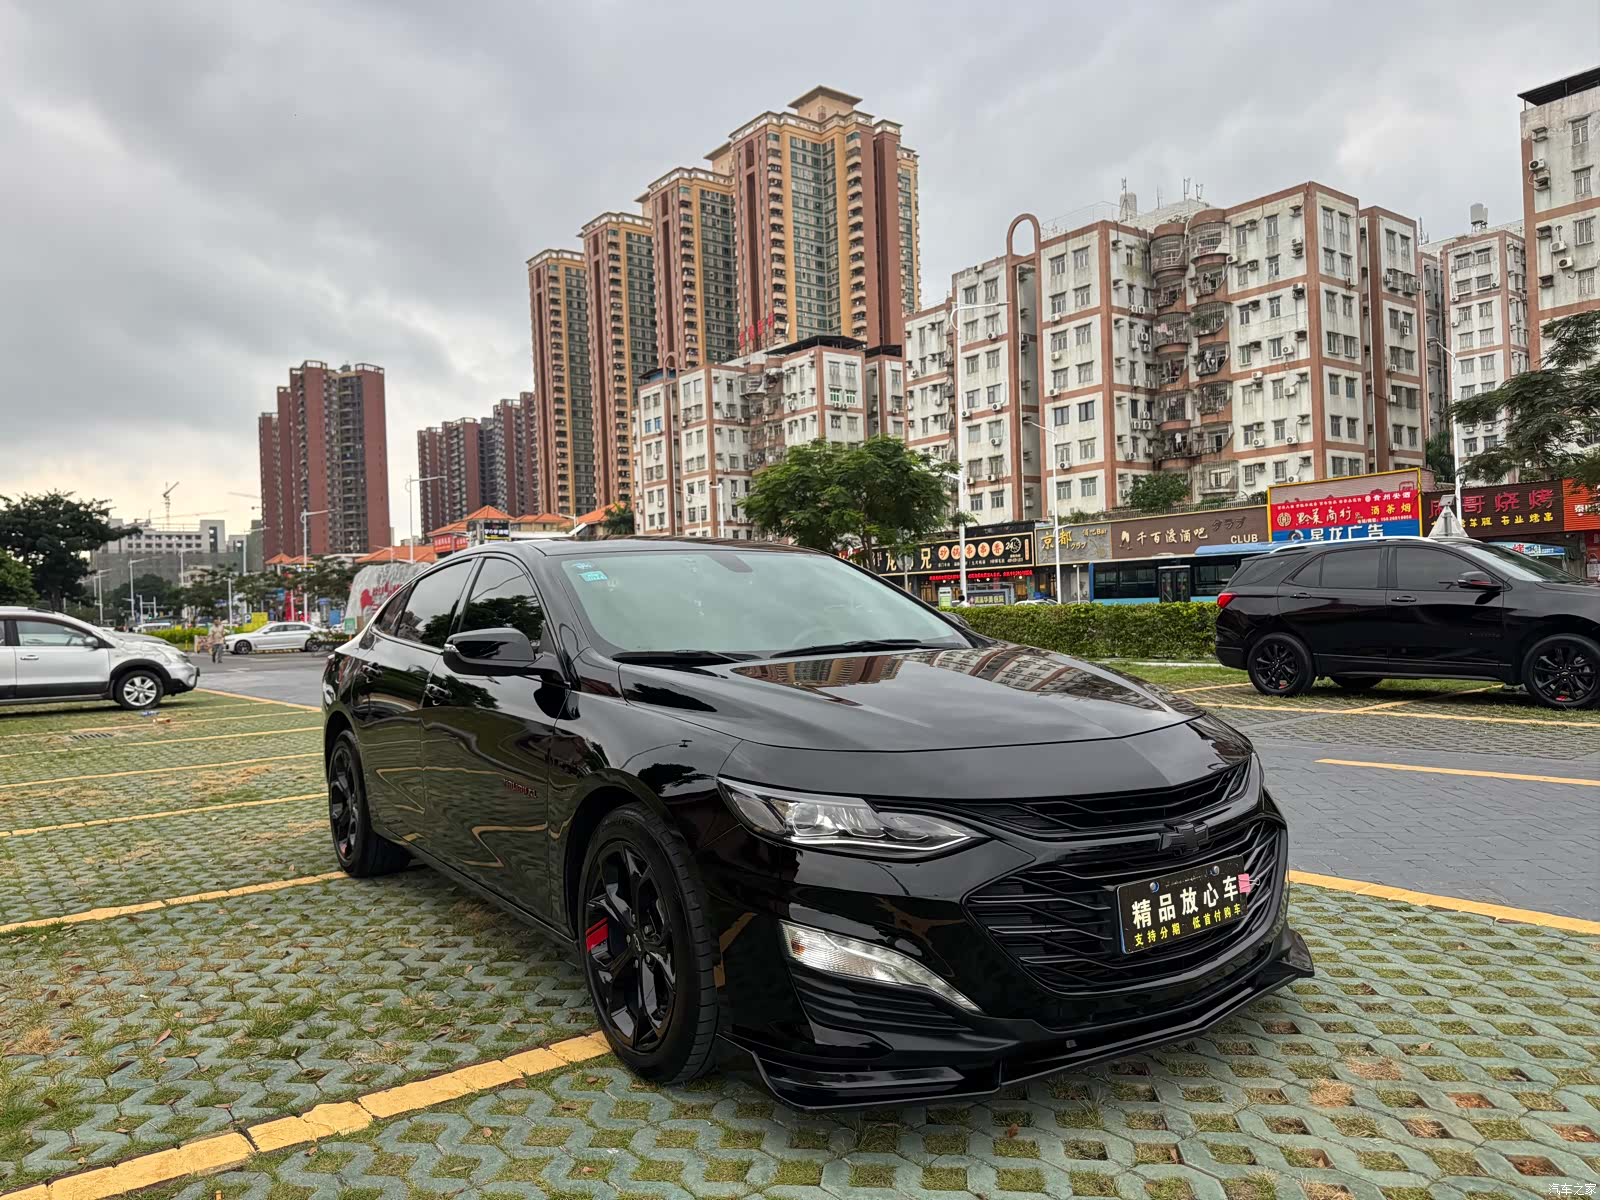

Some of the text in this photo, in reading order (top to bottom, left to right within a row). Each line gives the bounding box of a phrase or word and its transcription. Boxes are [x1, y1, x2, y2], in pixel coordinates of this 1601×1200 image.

[1370, 503, 1411, 515] 酒茶烟
[1500, 512, 1554, 526] 专业烤串
[1041, 528, 1073, 549] 京都
[1230, 533, 1258, 544] CLUB
[939, 541, 1003, 560] 砂锅串串香
[1131, 875, 1240, 930] 精品放心车
[1134, 903, 1242, 947] 支持分期 低首付购车
